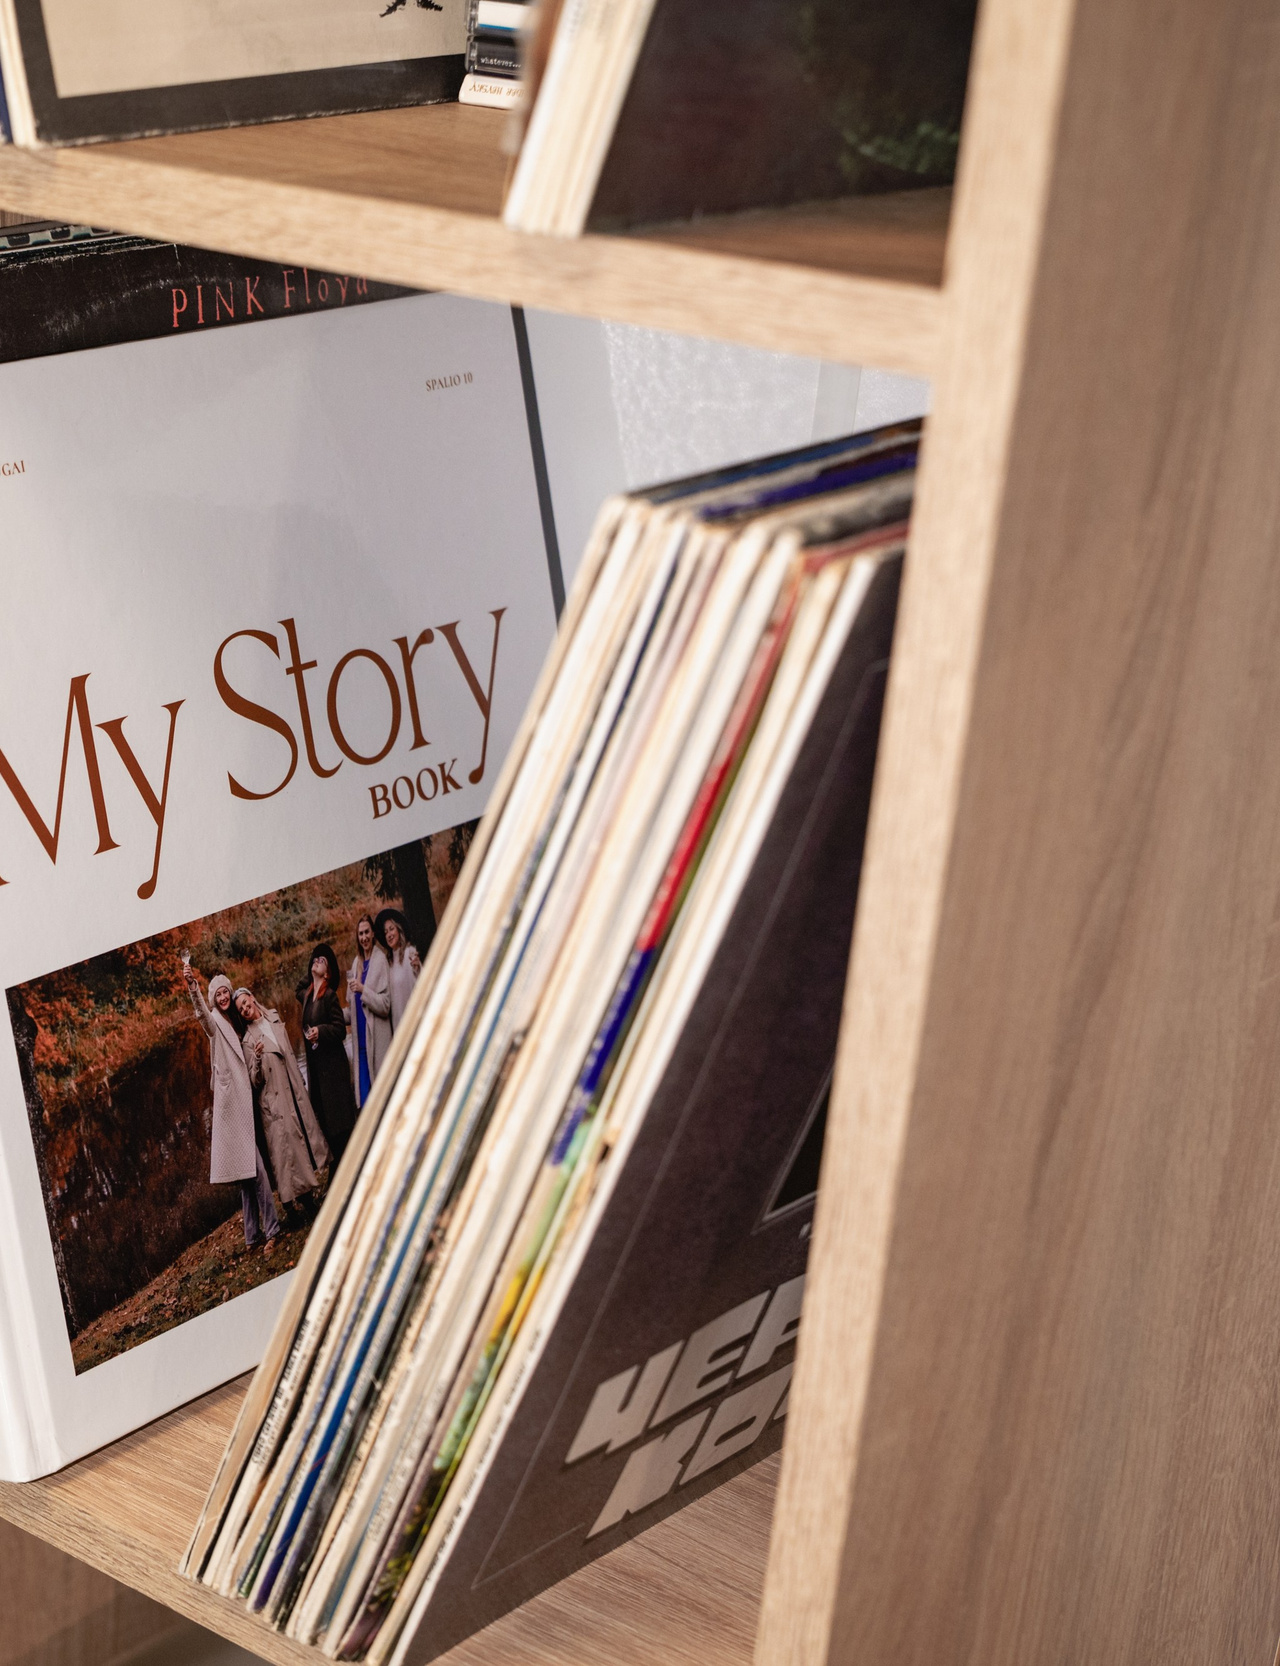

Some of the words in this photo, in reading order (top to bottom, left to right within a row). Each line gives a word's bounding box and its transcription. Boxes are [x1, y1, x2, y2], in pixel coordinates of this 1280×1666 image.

[171, 276, 265, 328] PINK
[425, 374, 462, 392] SPALIO
[463, 371, 474, 385] 10
[213, 607, 508, 801] Story
[367, 758, 463, 820] BOOK
[584, 1361, 796, 1541] КО
